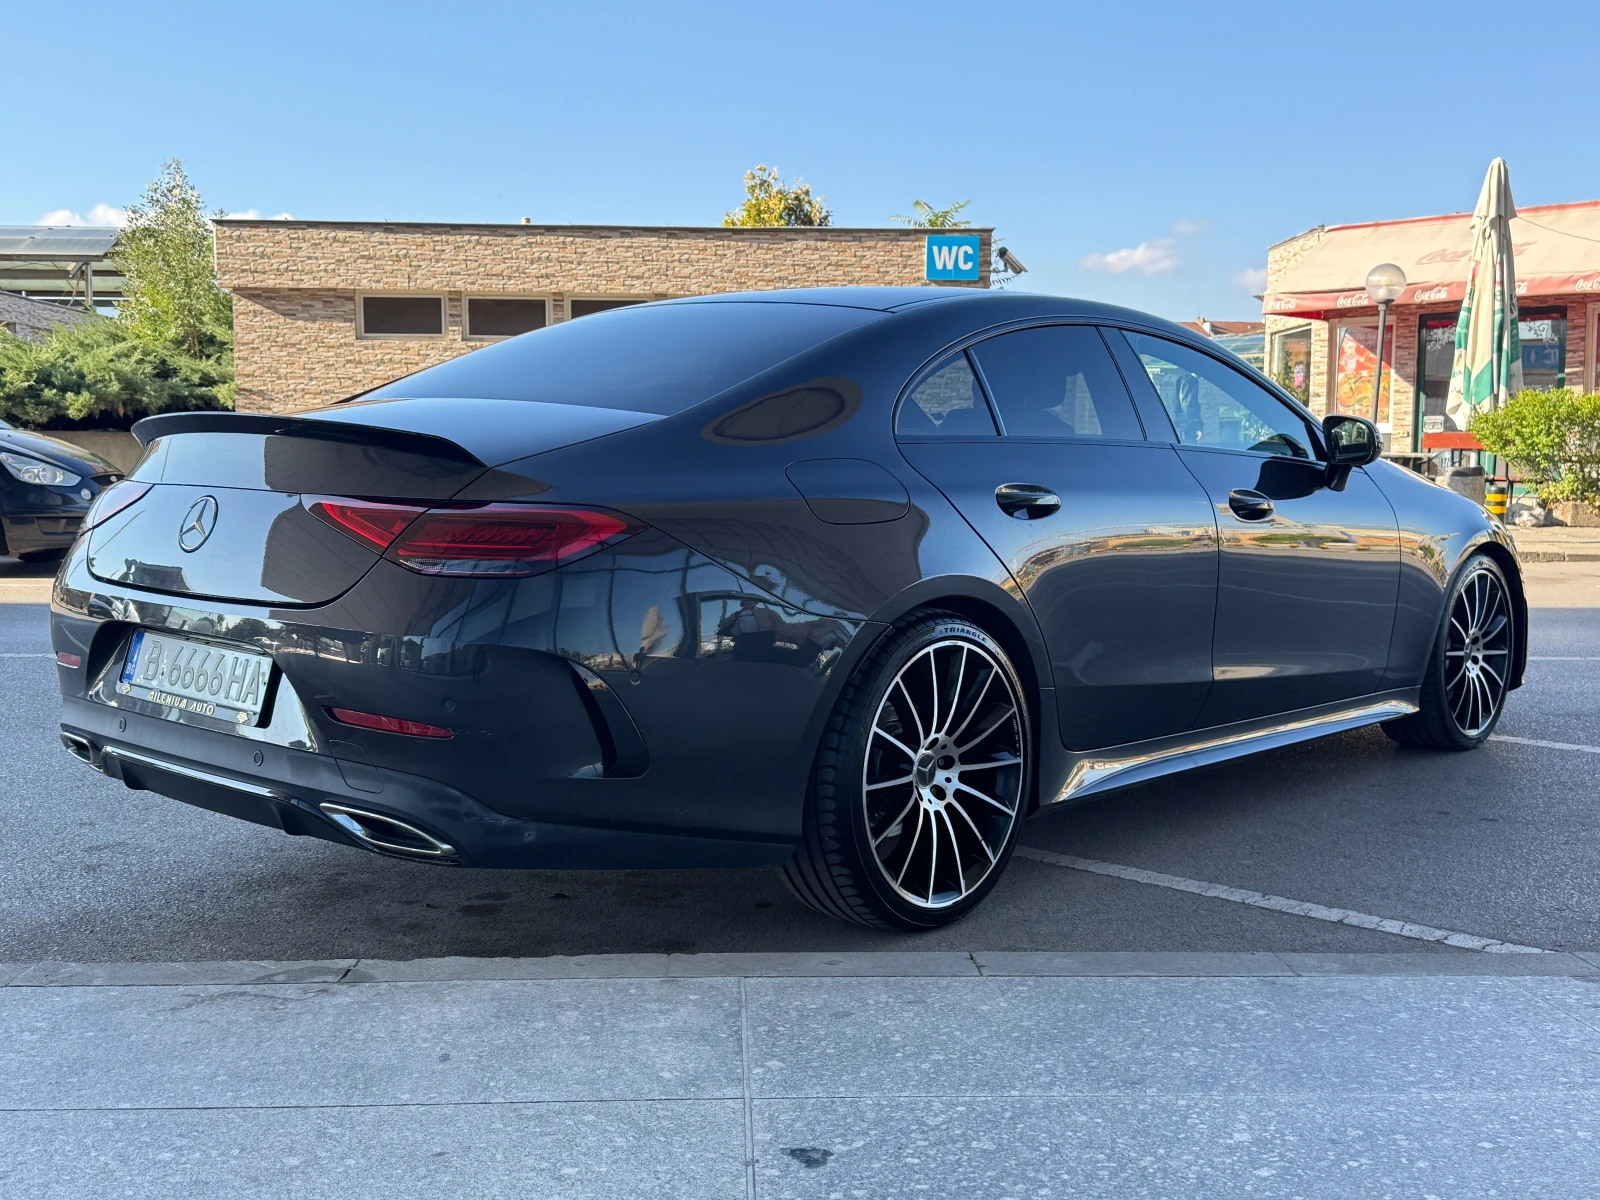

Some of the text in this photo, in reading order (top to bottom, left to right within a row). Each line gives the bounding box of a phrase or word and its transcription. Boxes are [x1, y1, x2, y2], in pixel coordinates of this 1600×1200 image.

[932, 245, 974, 271] WC
[943, 626, 988, 643] TRIANGLE
[125, 662, 136, 675] BG
[189, 701, 215, 716] AUTO
